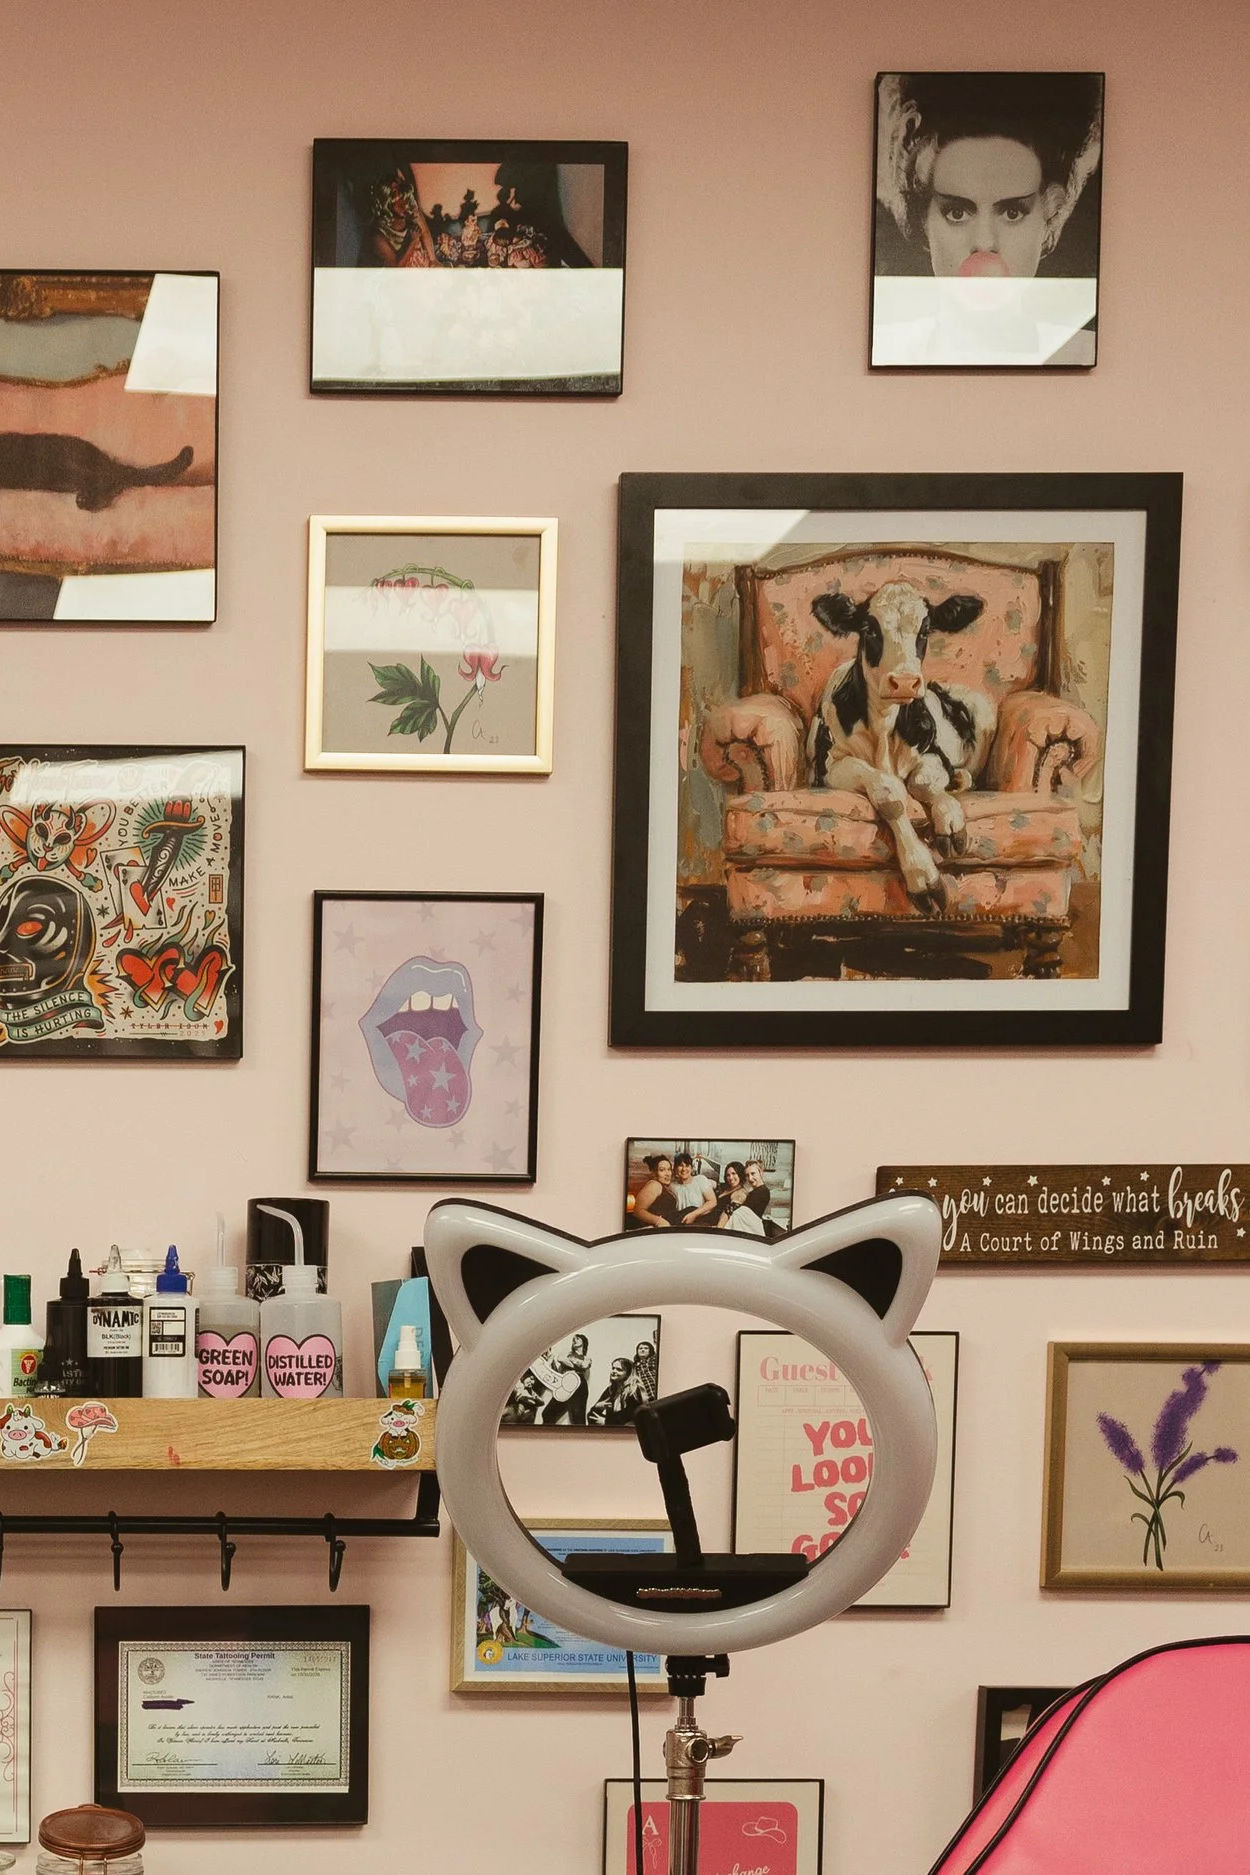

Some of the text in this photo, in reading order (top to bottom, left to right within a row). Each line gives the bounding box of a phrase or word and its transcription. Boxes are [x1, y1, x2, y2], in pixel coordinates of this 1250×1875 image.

[168, 867, 207, 888] MAKE
[210, 812, 224, 855] MOVE
[5, 992, 86, 1023] THE SILENCE
[16, 1008, 93, 1039] IS HURTING
[942, 1166, 1245, 1251] you can decide what breaks
[959, 1230, 1219, 1254] A Court of Wings and Ruin
[92, 1310, 141, 1328] DYNAMIC
[199, 1348, 254, 1367] GREEN
[267, 1354, 334, 1370] DISTILLED
[202, 1369, 250, 1386] SOAP!
[759, 1355, 842, 1382] Guest
[13, 1377, 38, 1388] Bactin
[273, 1371, 328, 1387] WATER!
[791, 1452, 874, 1493] LOO
[194, 1652, 275, 1661] State Tattooing Permit
[507, 1652, 658, 1663] LAKE SUPERIOR STATE UNIVRSITY
[642, 1815, 659, 1836] A
